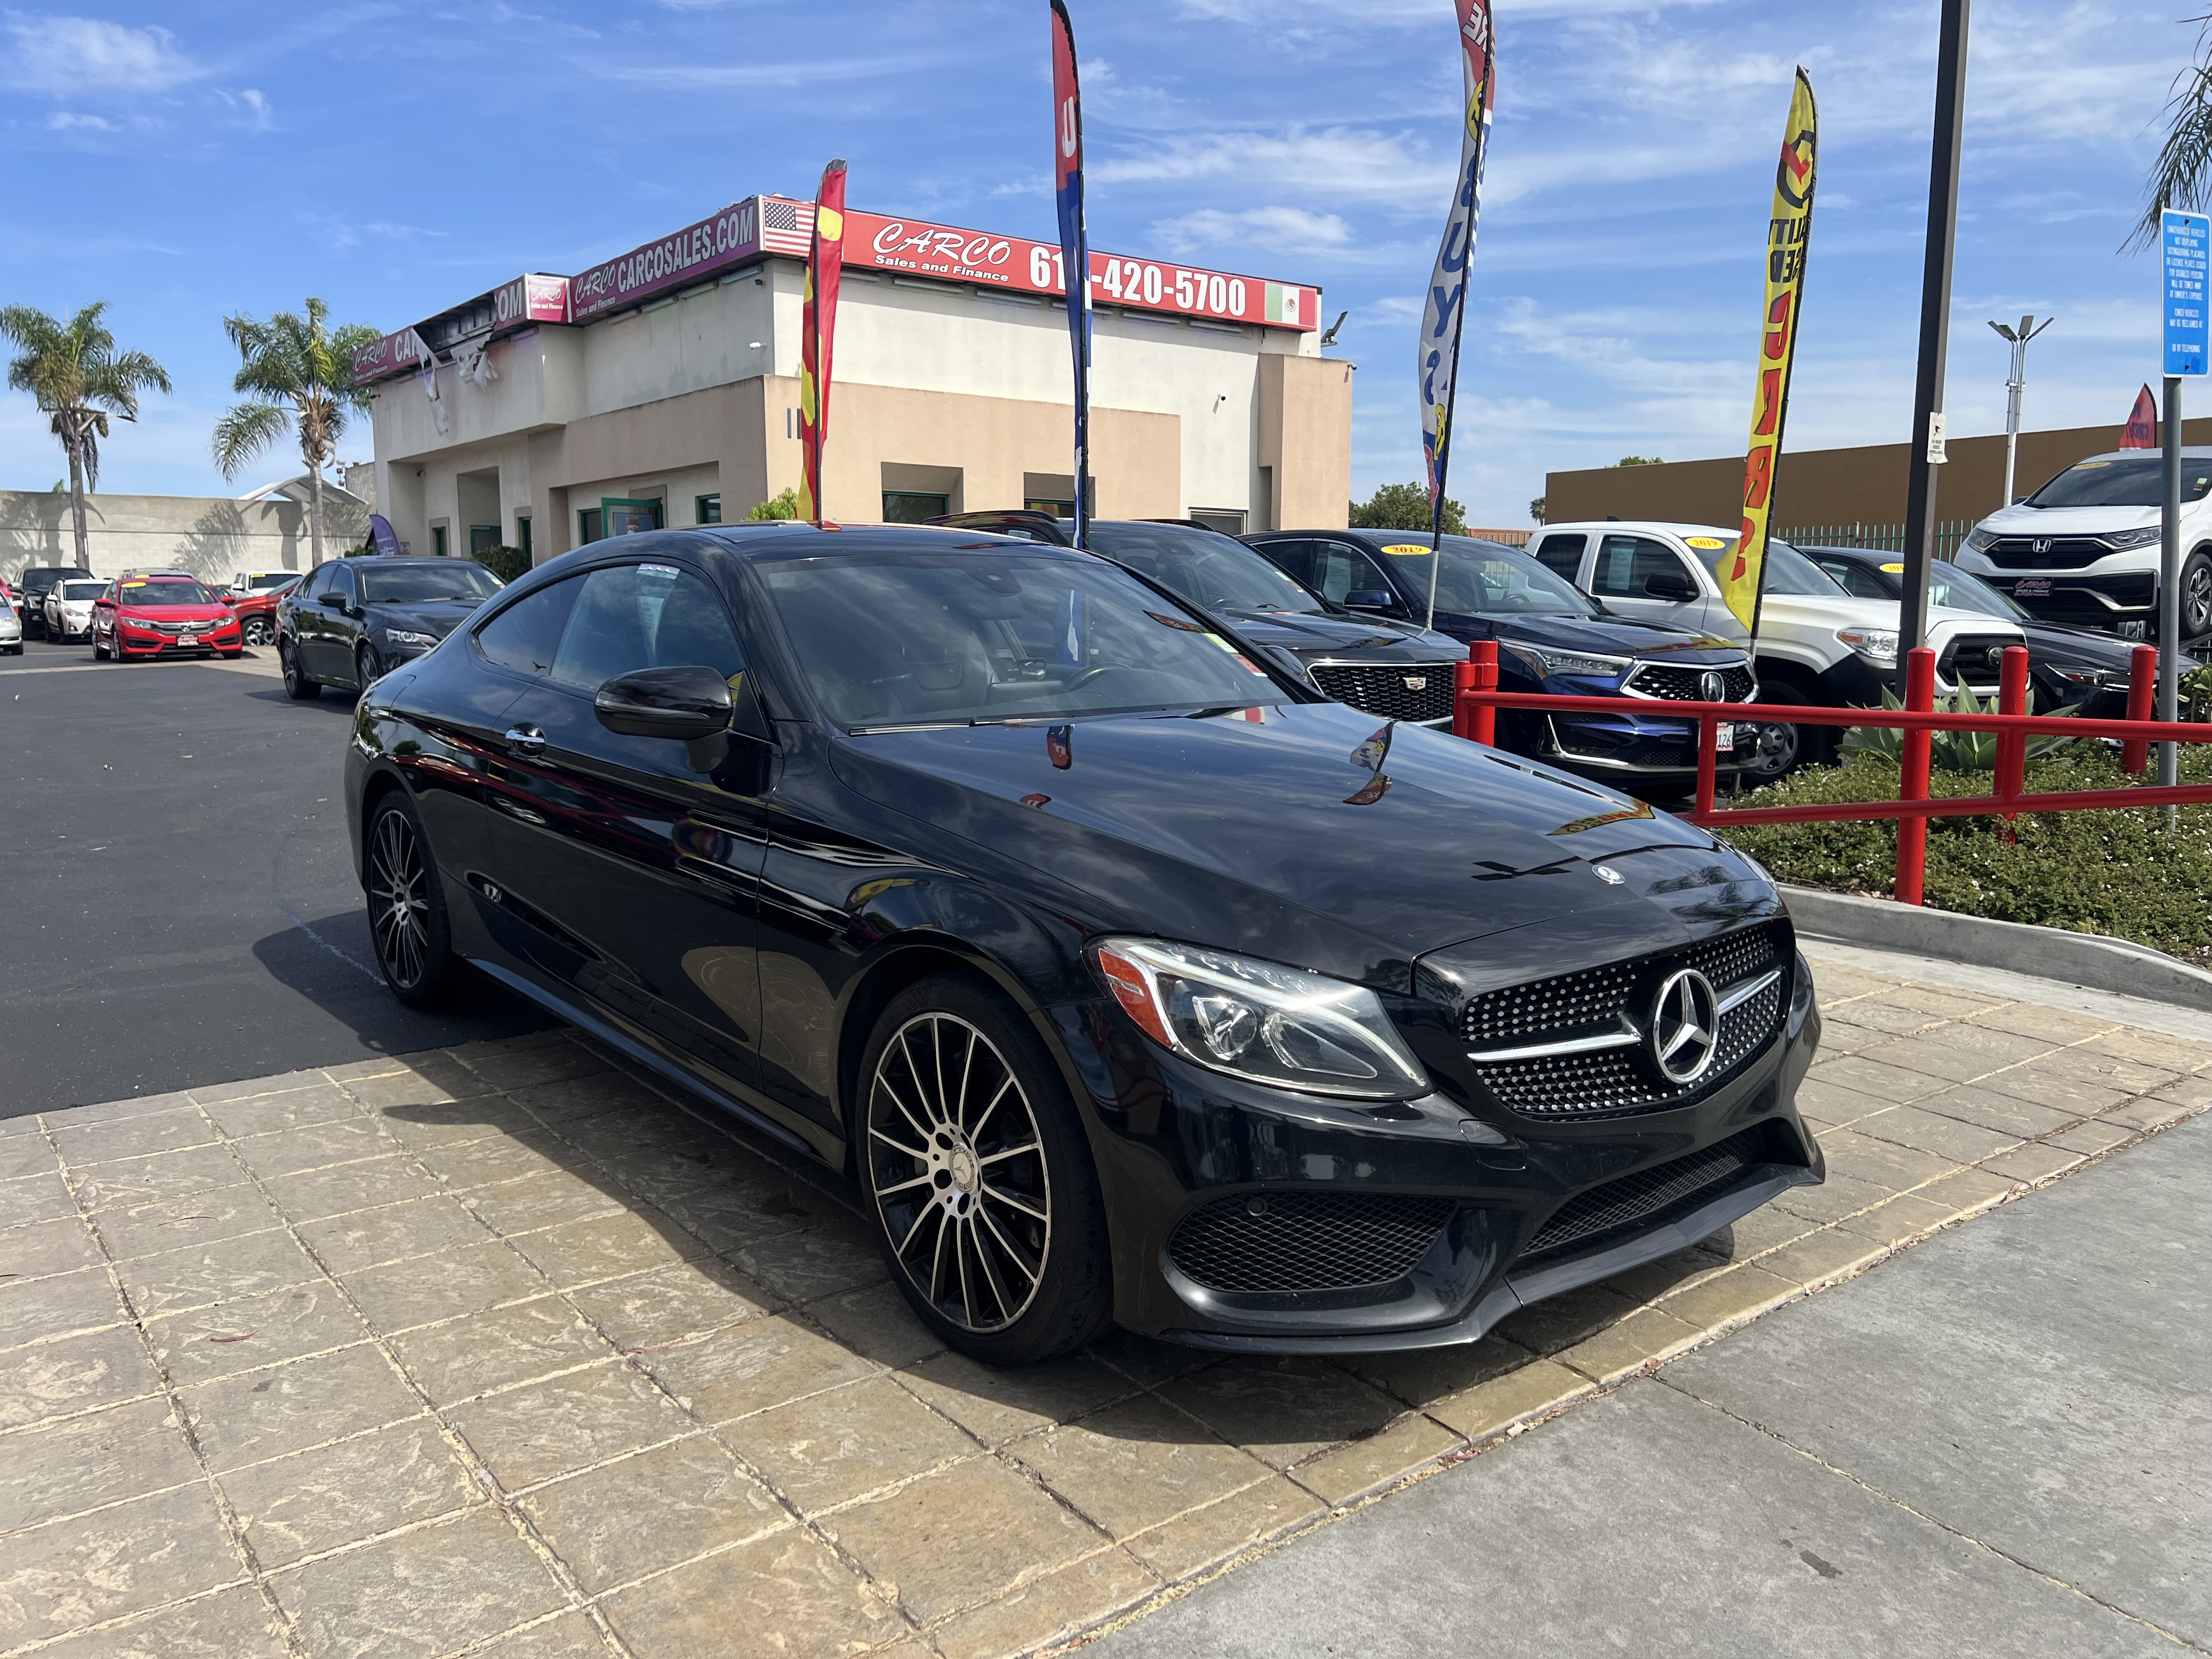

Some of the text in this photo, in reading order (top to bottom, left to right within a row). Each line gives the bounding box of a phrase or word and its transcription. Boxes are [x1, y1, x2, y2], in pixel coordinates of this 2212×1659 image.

[618, 205, 754, 294] CARCOSALES.COM
[872, 222, 1011, 266] CARCO
[575, 264, 616, 304] CARCO
[874, 254, 1009, 282] Sales and Finance
[1029, 245, 1246, 317] 61-420-5700
[495, 281, 522, 323] OM
[529, 285, 562, 302] CARCO
[576, 295, 616, 319] Sales and Finance
[356, 340, 387, 372] CARCO
